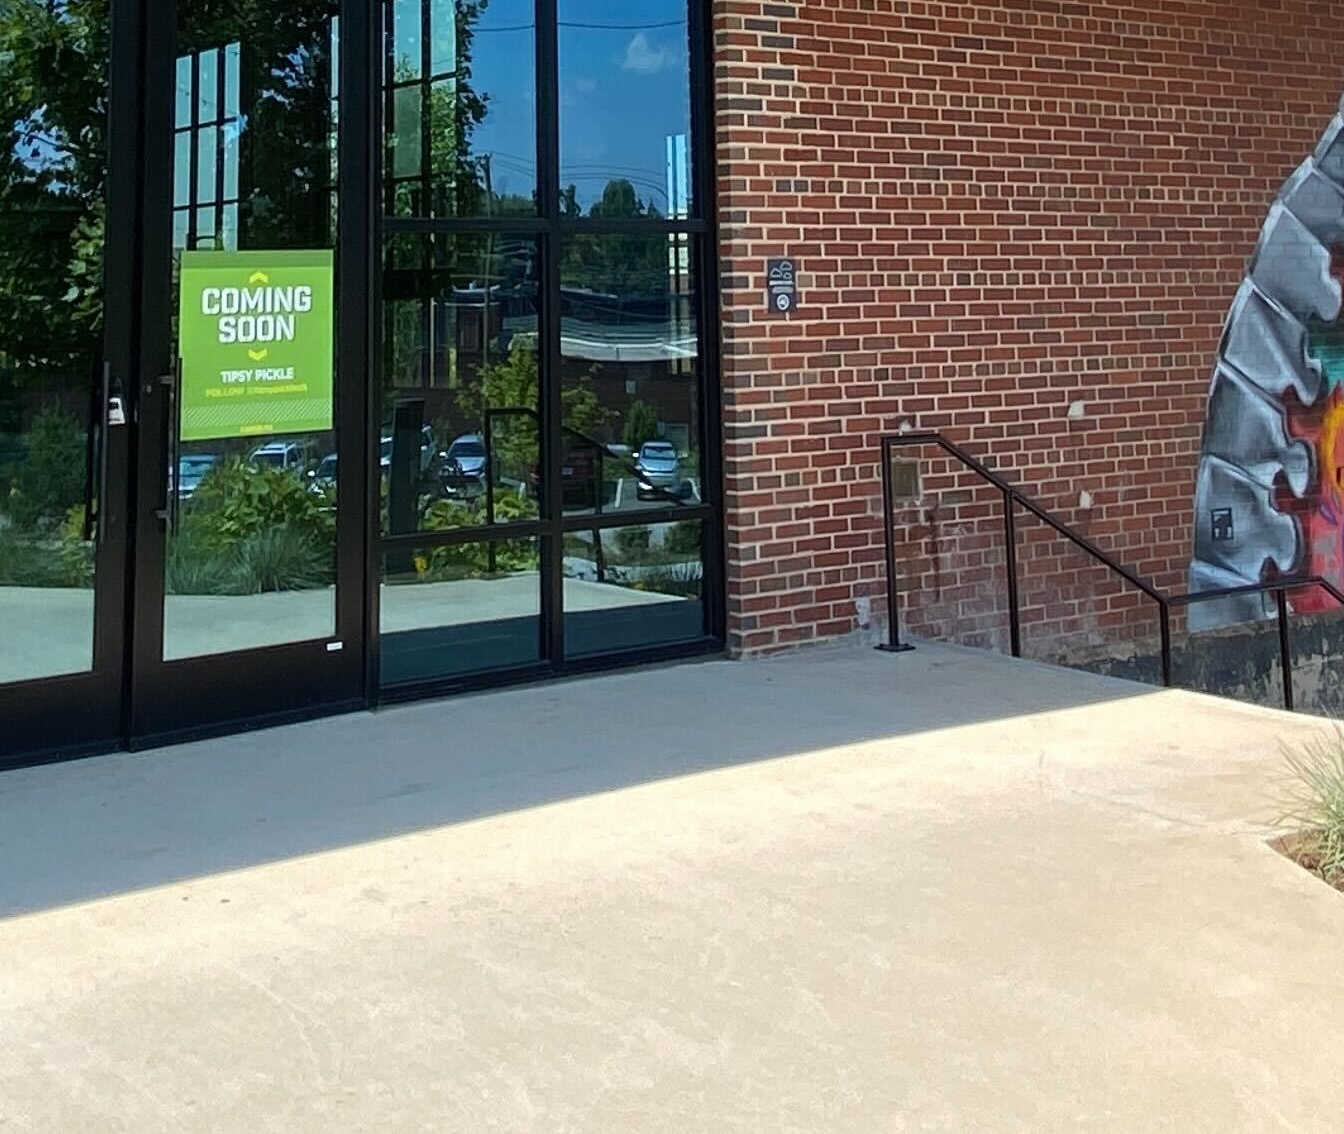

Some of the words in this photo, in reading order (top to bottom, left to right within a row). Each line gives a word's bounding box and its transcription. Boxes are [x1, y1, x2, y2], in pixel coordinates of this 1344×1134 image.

[202, 286, 312, 315] COMING
[218, 315, 295, 343] SOON
[220, 369, 253, 383] TIPSY
[255, 367, 294, 381] PICKLE
[205, 386, 245, 398] FOLLOW
